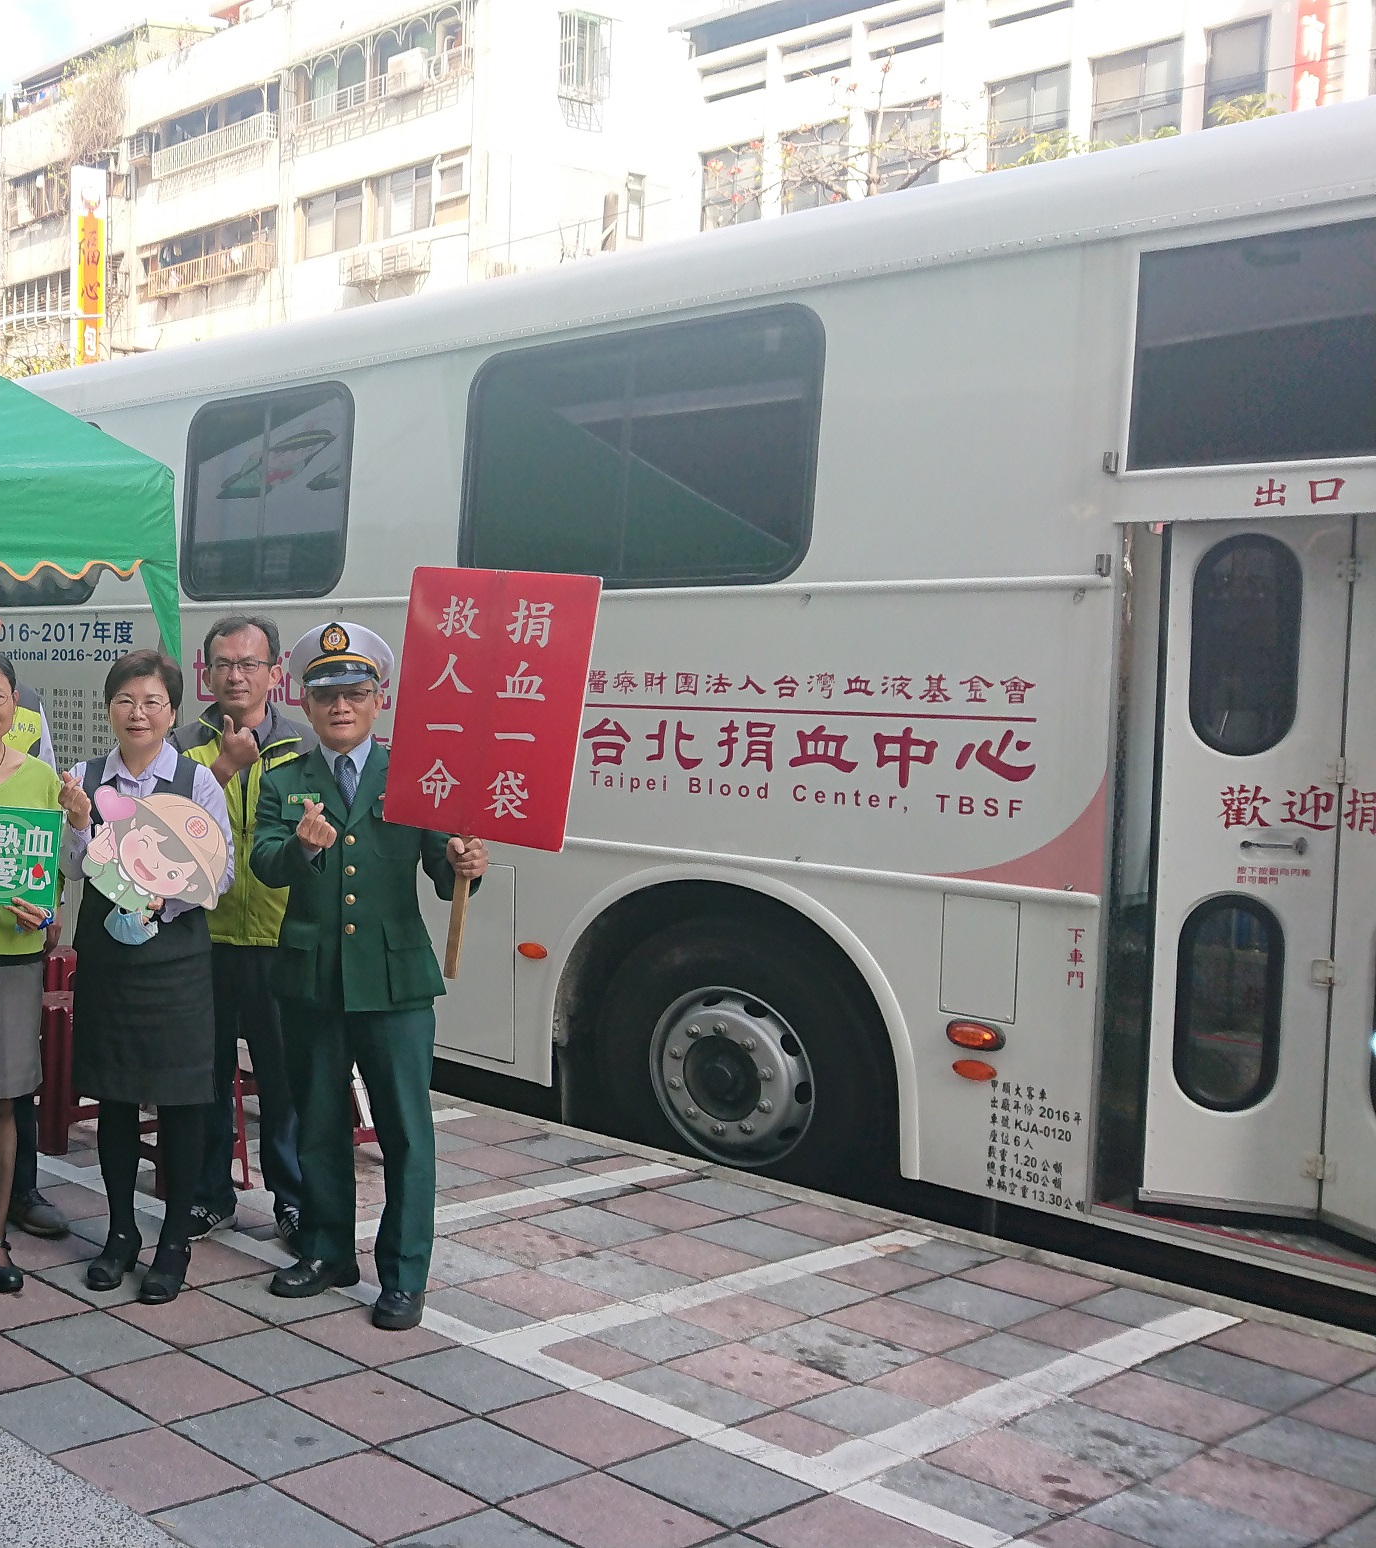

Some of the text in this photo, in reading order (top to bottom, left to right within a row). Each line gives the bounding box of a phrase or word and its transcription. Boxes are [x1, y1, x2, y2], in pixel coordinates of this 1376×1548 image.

[1253, 477, 1347, 508] 出口
[416, 595, 481, 809] 救人一命
[483, 598, 554, 819] 捐血一袋
[587, 669, 1036, 706] 醫療財團法人台灣血液基金會
[582, 717, 1037, 788] 台北捐血中心
[589, 770, 1023, 819] Taipei Blood Center, TBSF
[1217, 784, 1376, 835] 歡迎捐
[1067, 928, 1086, 989] 下車門
